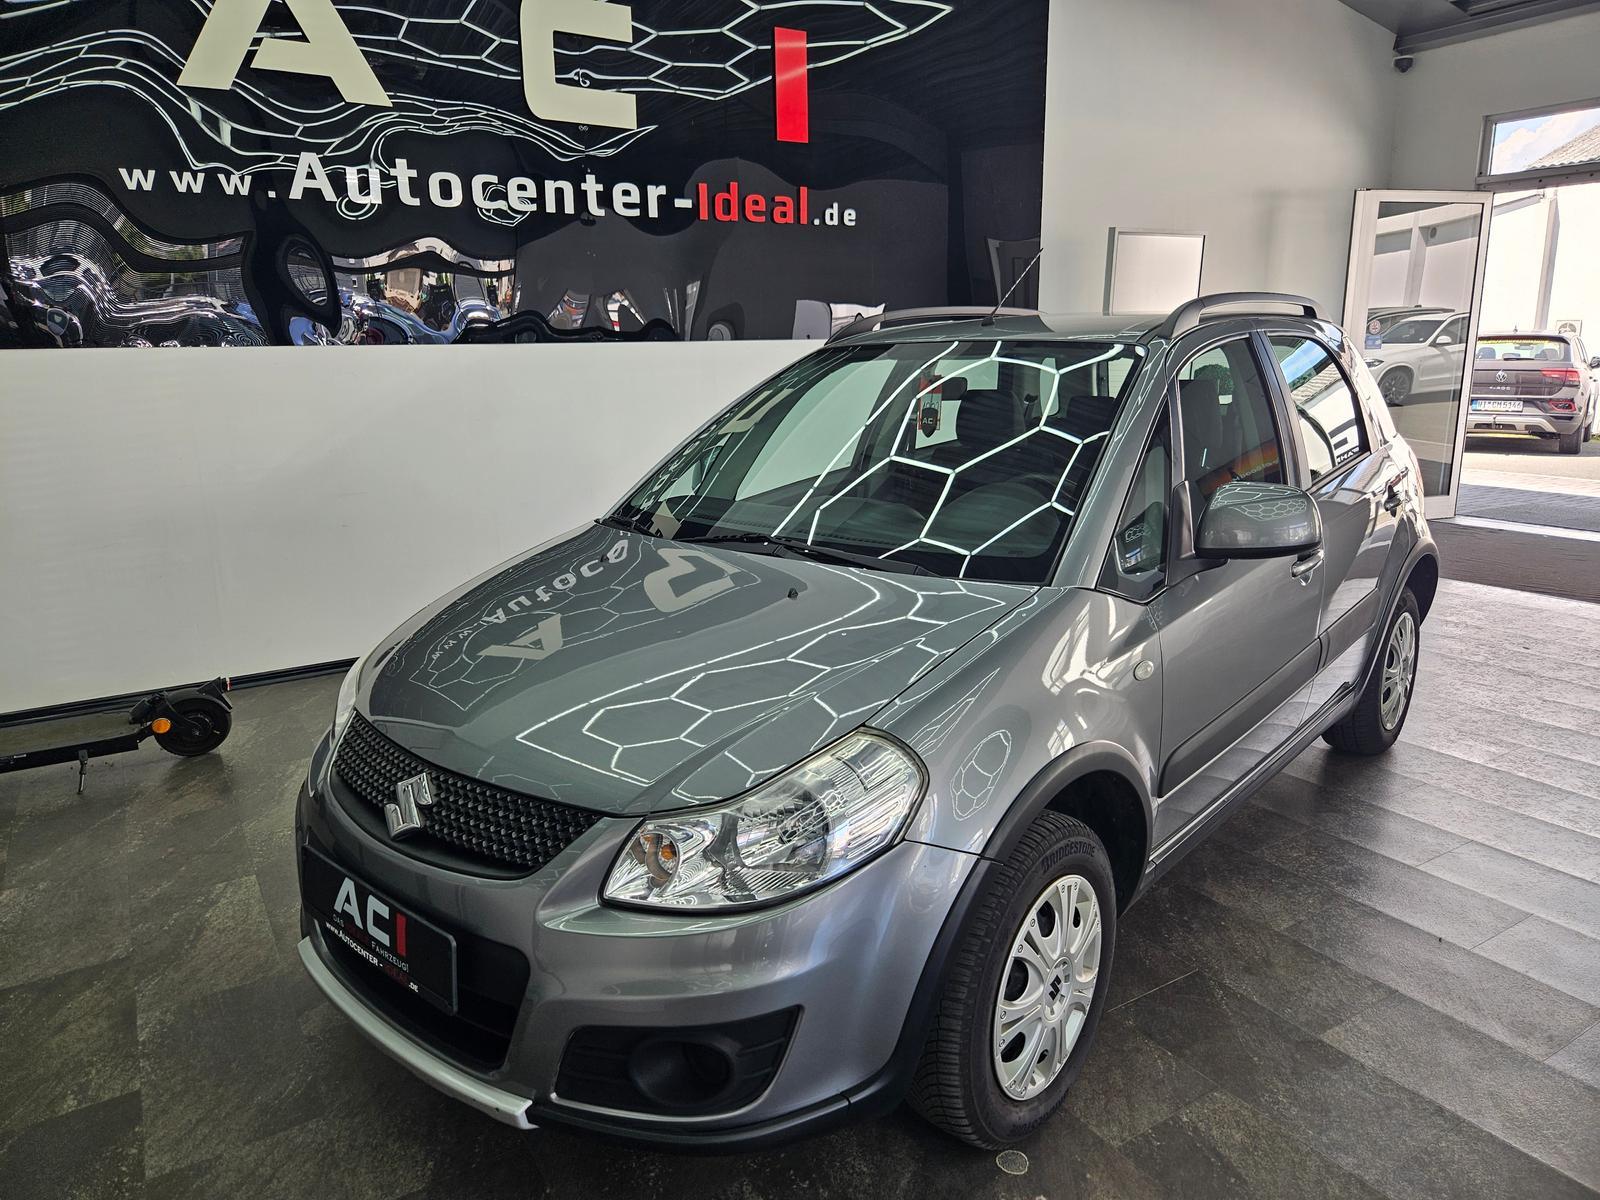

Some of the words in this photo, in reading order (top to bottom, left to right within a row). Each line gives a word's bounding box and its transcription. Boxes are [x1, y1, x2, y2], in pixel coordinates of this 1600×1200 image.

[118, 152, 858, 227] www.Autocenter-Ideal.de
[1041, 841, 1096, 874] BRIDGESTONE
[333, 876, 407, 957] ACI
